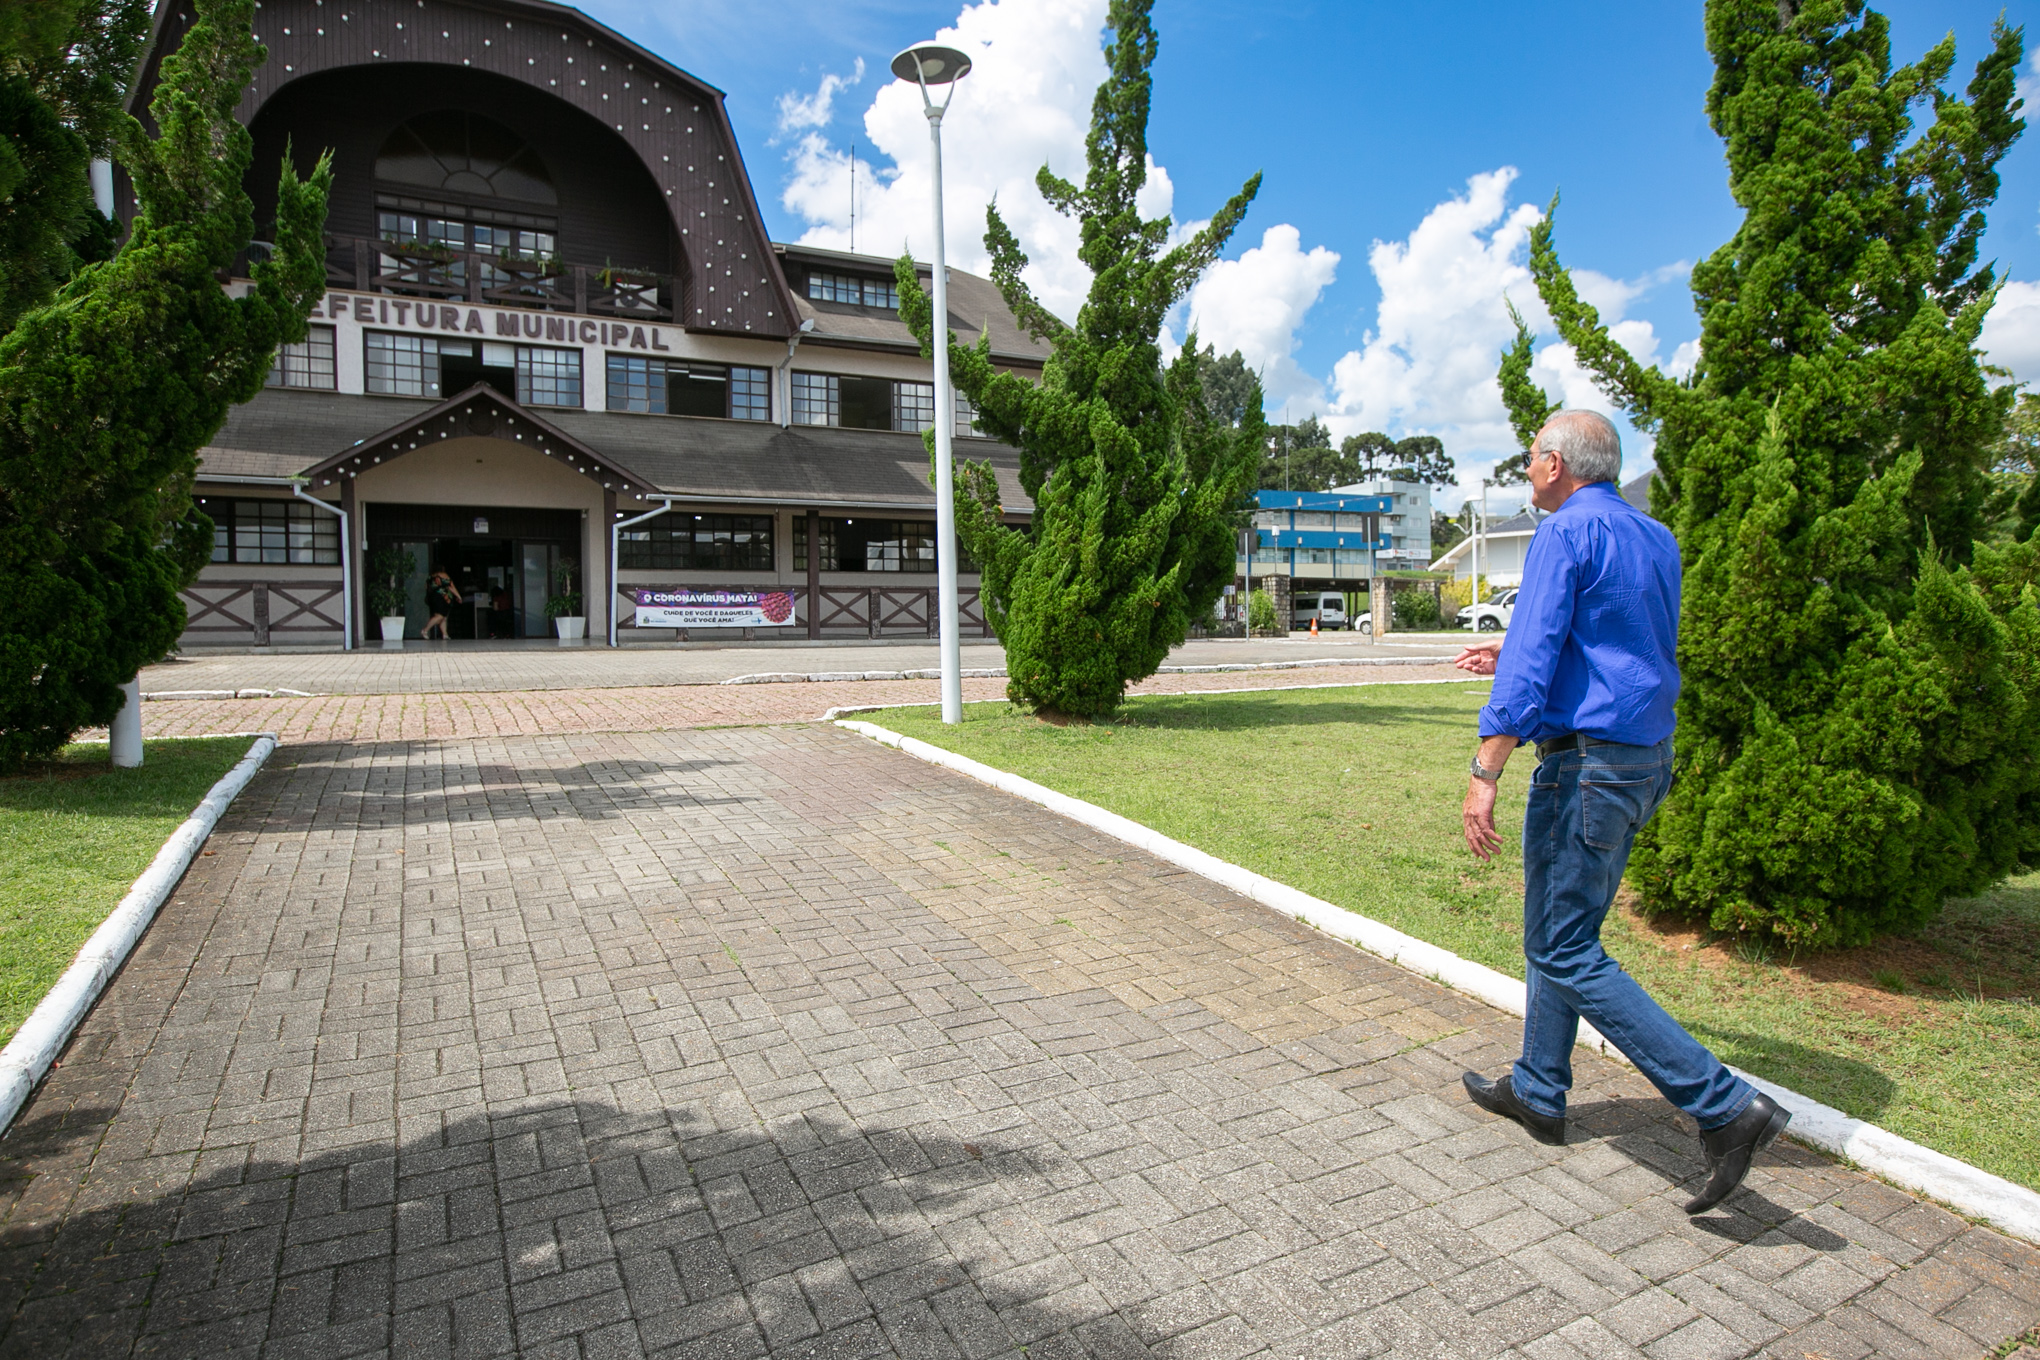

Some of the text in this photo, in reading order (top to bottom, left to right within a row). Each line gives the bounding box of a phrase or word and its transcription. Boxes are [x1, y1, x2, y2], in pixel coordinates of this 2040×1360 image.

[247, 285, 669, 351] FEITURA MUNICIPAL
[643, 594, 652, 602] O
[653, 593, 726, 603] CORONAVÍRUS
